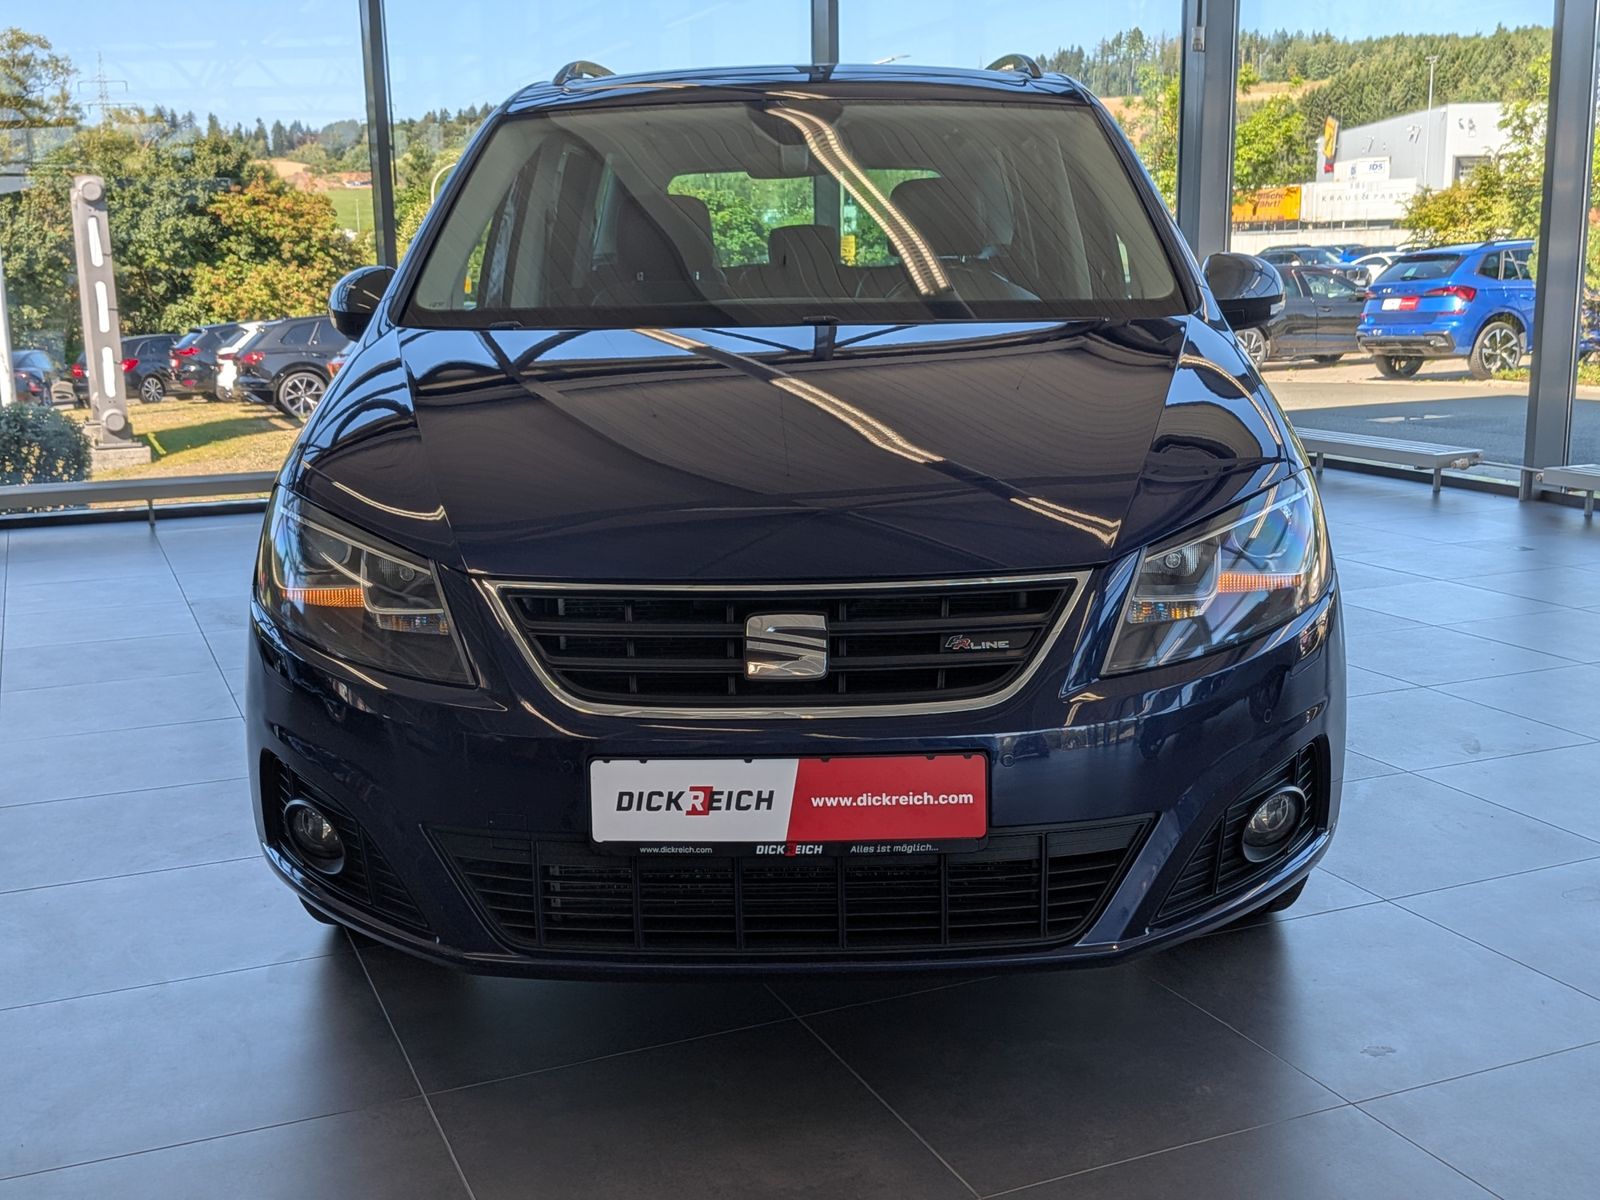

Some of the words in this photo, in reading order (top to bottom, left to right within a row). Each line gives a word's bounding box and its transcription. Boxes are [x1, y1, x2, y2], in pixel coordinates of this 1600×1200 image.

[970, 640, 1009, 650] LINE
[616, 788, 774, 815] DICKREICH
[811, 792, 974, 807] www.dickreich.com
[639, 846, 713, 854] www.dickreich.com
[849, 845, 874, 853] Alles
[876, 844, 891, 853] ist
